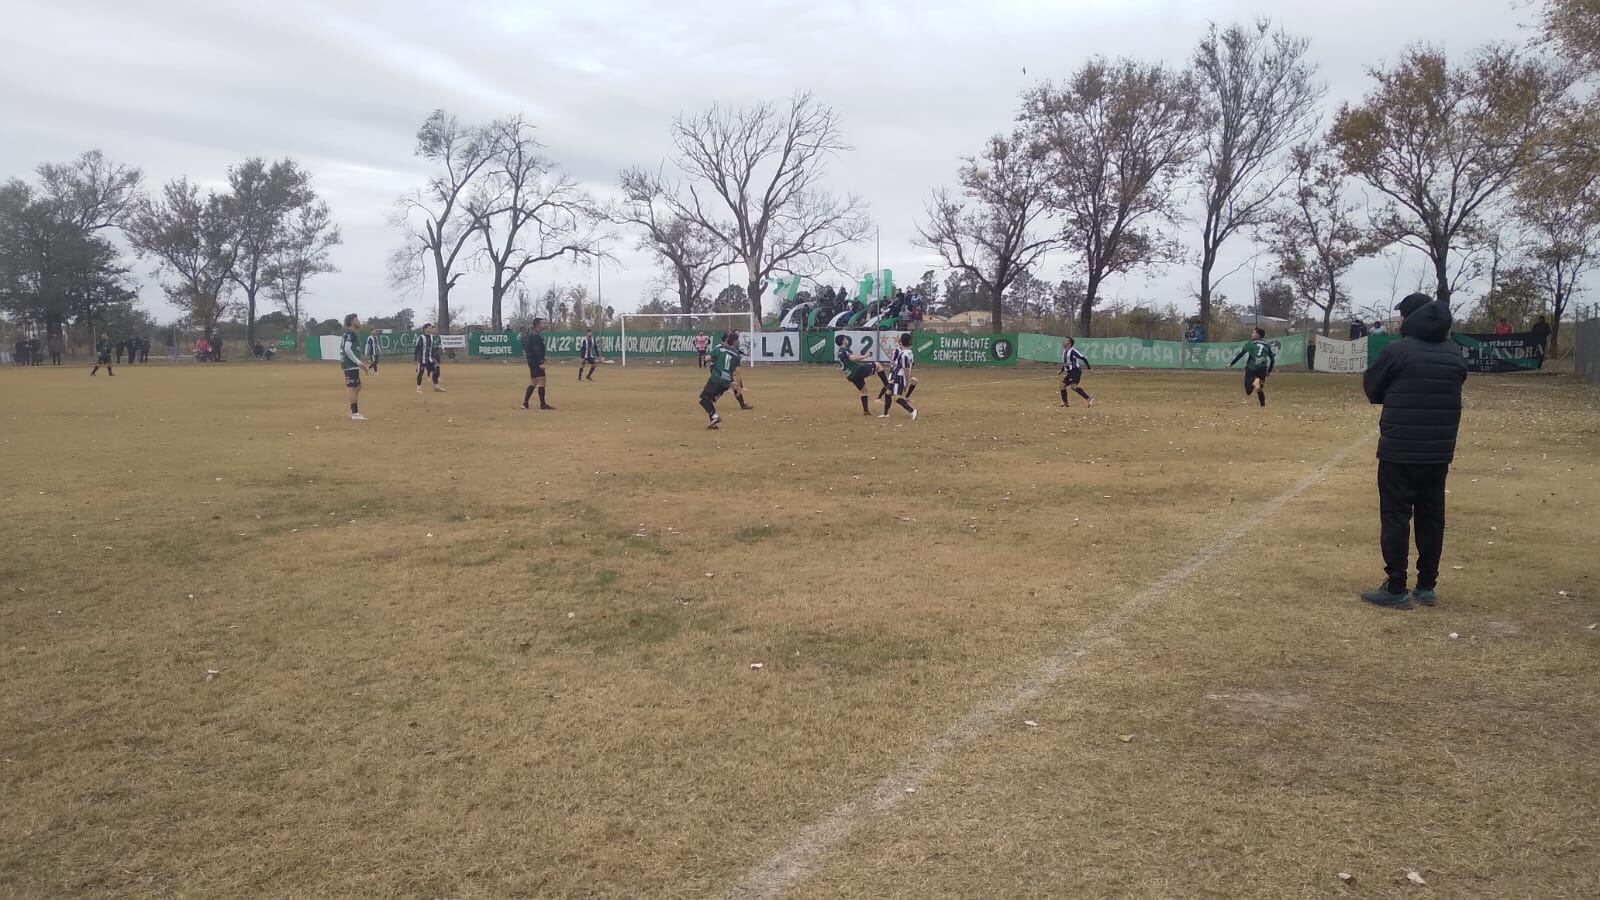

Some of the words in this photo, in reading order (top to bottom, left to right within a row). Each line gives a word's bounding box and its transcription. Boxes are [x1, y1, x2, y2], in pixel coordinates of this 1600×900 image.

[480, 334, 509, 343] CACHITO
[479, 346, 513, 354] PRESENTE
[1103, 343, 1128, 360] NO
[1256, 343, 1265, 356] 7
